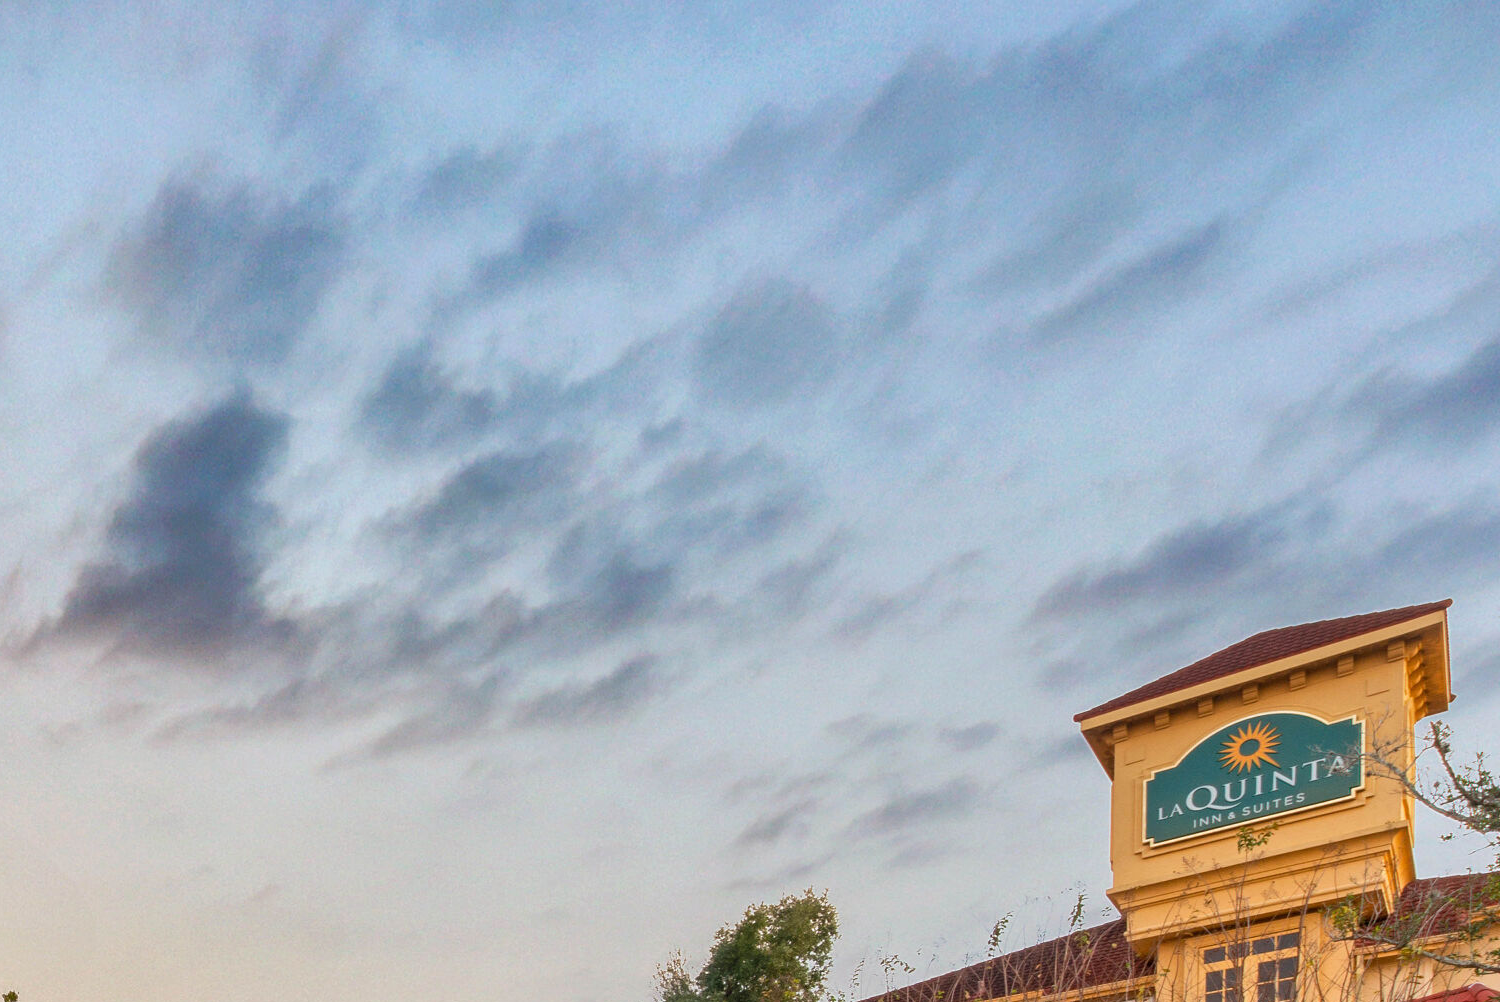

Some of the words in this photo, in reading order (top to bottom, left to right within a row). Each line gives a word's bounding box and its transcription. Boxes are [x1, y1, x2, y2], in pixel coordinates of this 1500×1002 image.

[1193, 813, 1222, 828] INN
[1227, 811, 1237, 820] &
[1242, 792, 1306, 816] SUITES
